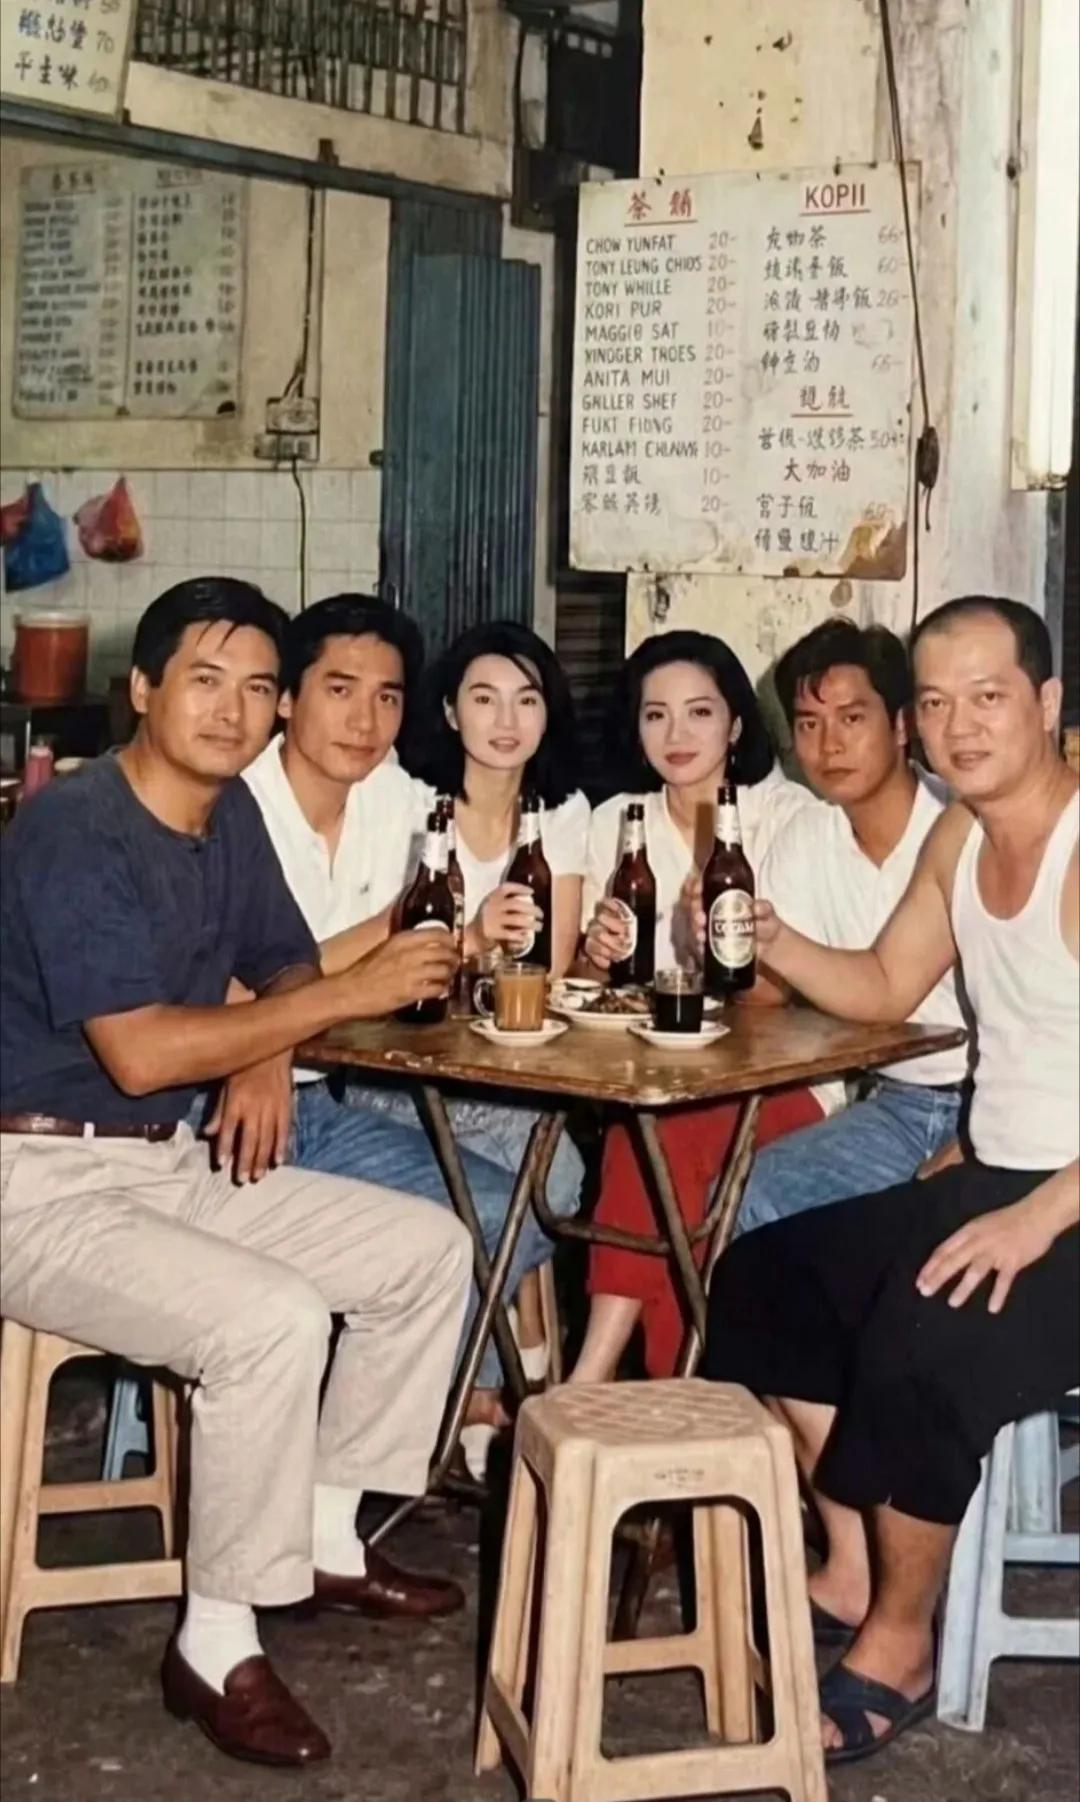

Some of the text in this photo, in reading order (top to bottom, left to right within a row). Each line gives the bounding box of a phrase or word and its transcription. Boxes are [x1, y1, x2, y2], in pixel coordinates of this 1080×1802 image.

[97, 30, 114, 53] 70
[805, 183, 866, 209] KOPII
[586, 238, 621, 255] CHOW
[626, 234, 676, 252] YUNFAT
[585, 260, 615, 277] TONY
[620, 258, 659, 275] LEUNG
[585, 281, 617, 297] TONY
[585, 302, 620, 319] KORI
[630, 299, 662, 318] PUR
[652, 322, 679, 341] SAT
[584, 370, 630, 387] ANITA
[641, 368, 670, 386] MUI
